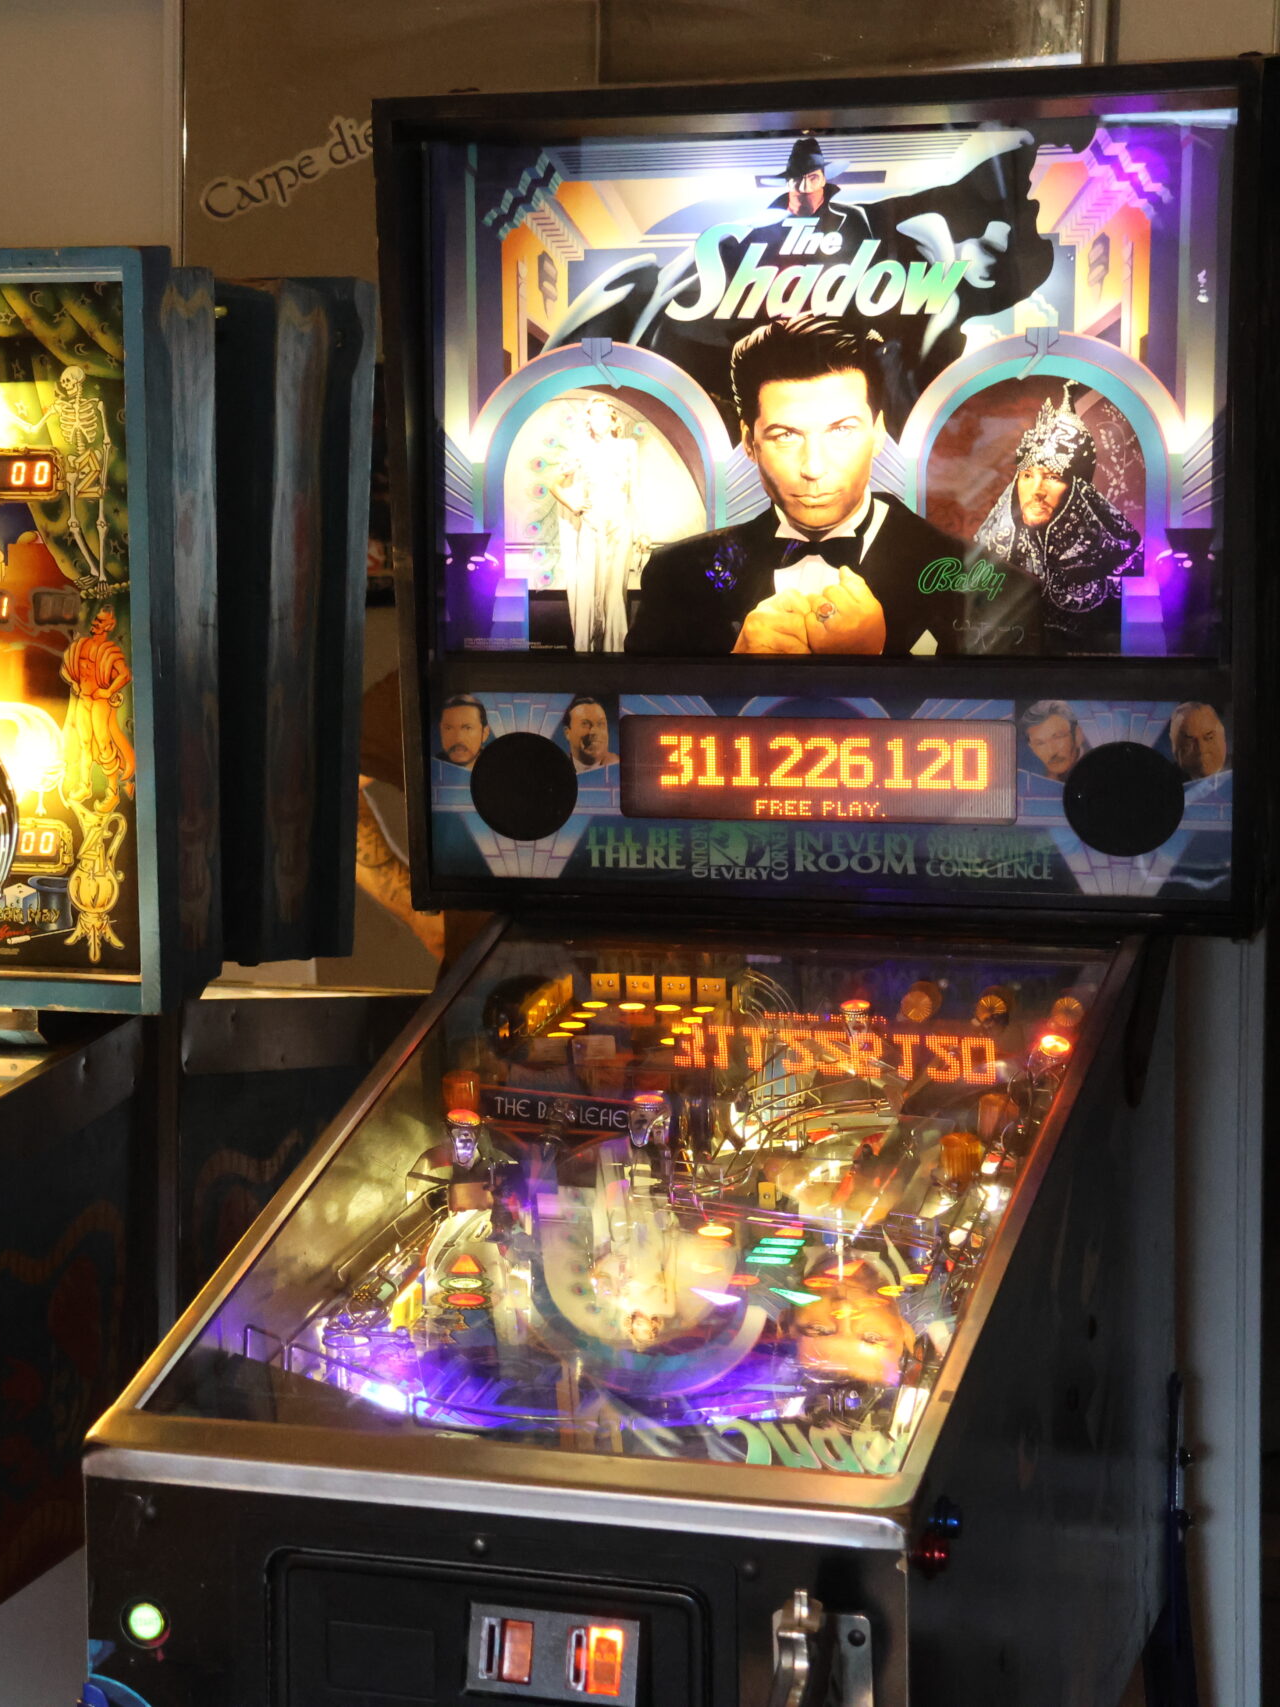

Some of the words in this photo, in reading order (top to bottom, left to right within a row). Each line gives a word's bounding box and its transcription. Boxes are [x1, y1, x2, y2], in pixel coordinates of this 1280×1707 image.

[204, 154, 320, 219] Carpe
[778, 215, 844, 257] The
[665, 221, 971, 322] Shadow
[918, 556, 1005, 601] Bally
[659, 735, 989, 790] 311.226.120
[754, 799, 812, 817] FREE
[587, 825, 639, 847] I'LL
[648, 827, 684, 848] BE
[794, 829, 824, 852] IN
[831, 831, 915, 855] EVERY
[586, 845, 687, 870] THERE
[794, 851, 918, 875] ROOM
[925, 858, 1054, 881] CONSCIENCE
[710, 866, 771, 881] EVERY
[493, 1095, 531, 1118] THE
